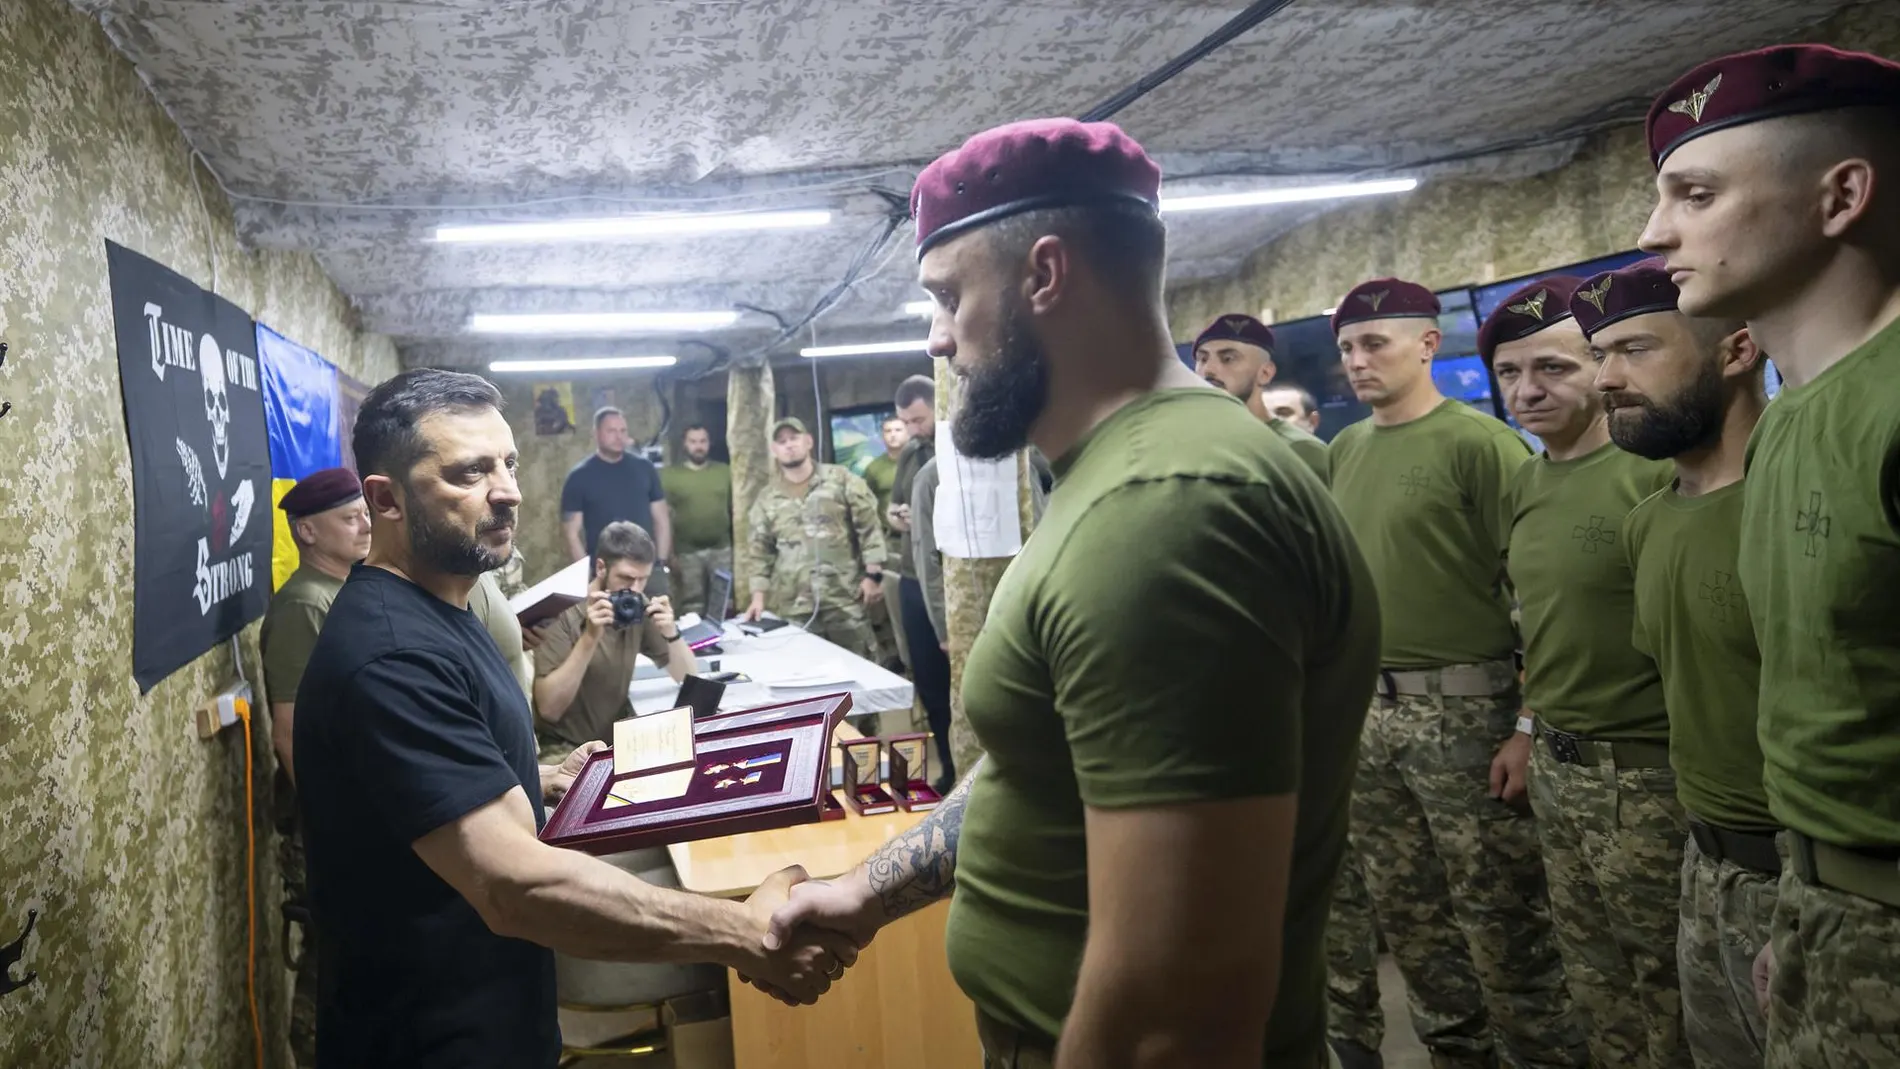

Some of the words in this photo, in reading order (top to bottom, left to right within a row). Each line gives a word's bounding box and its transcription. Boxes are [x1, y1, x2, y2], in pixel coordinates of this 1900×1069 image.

[144, 302, 196, 382] TIME
[226, 349, 239, 385] OF
[239, 353, 258, 391] THE
[192, 536, 253, 616] STRONG
